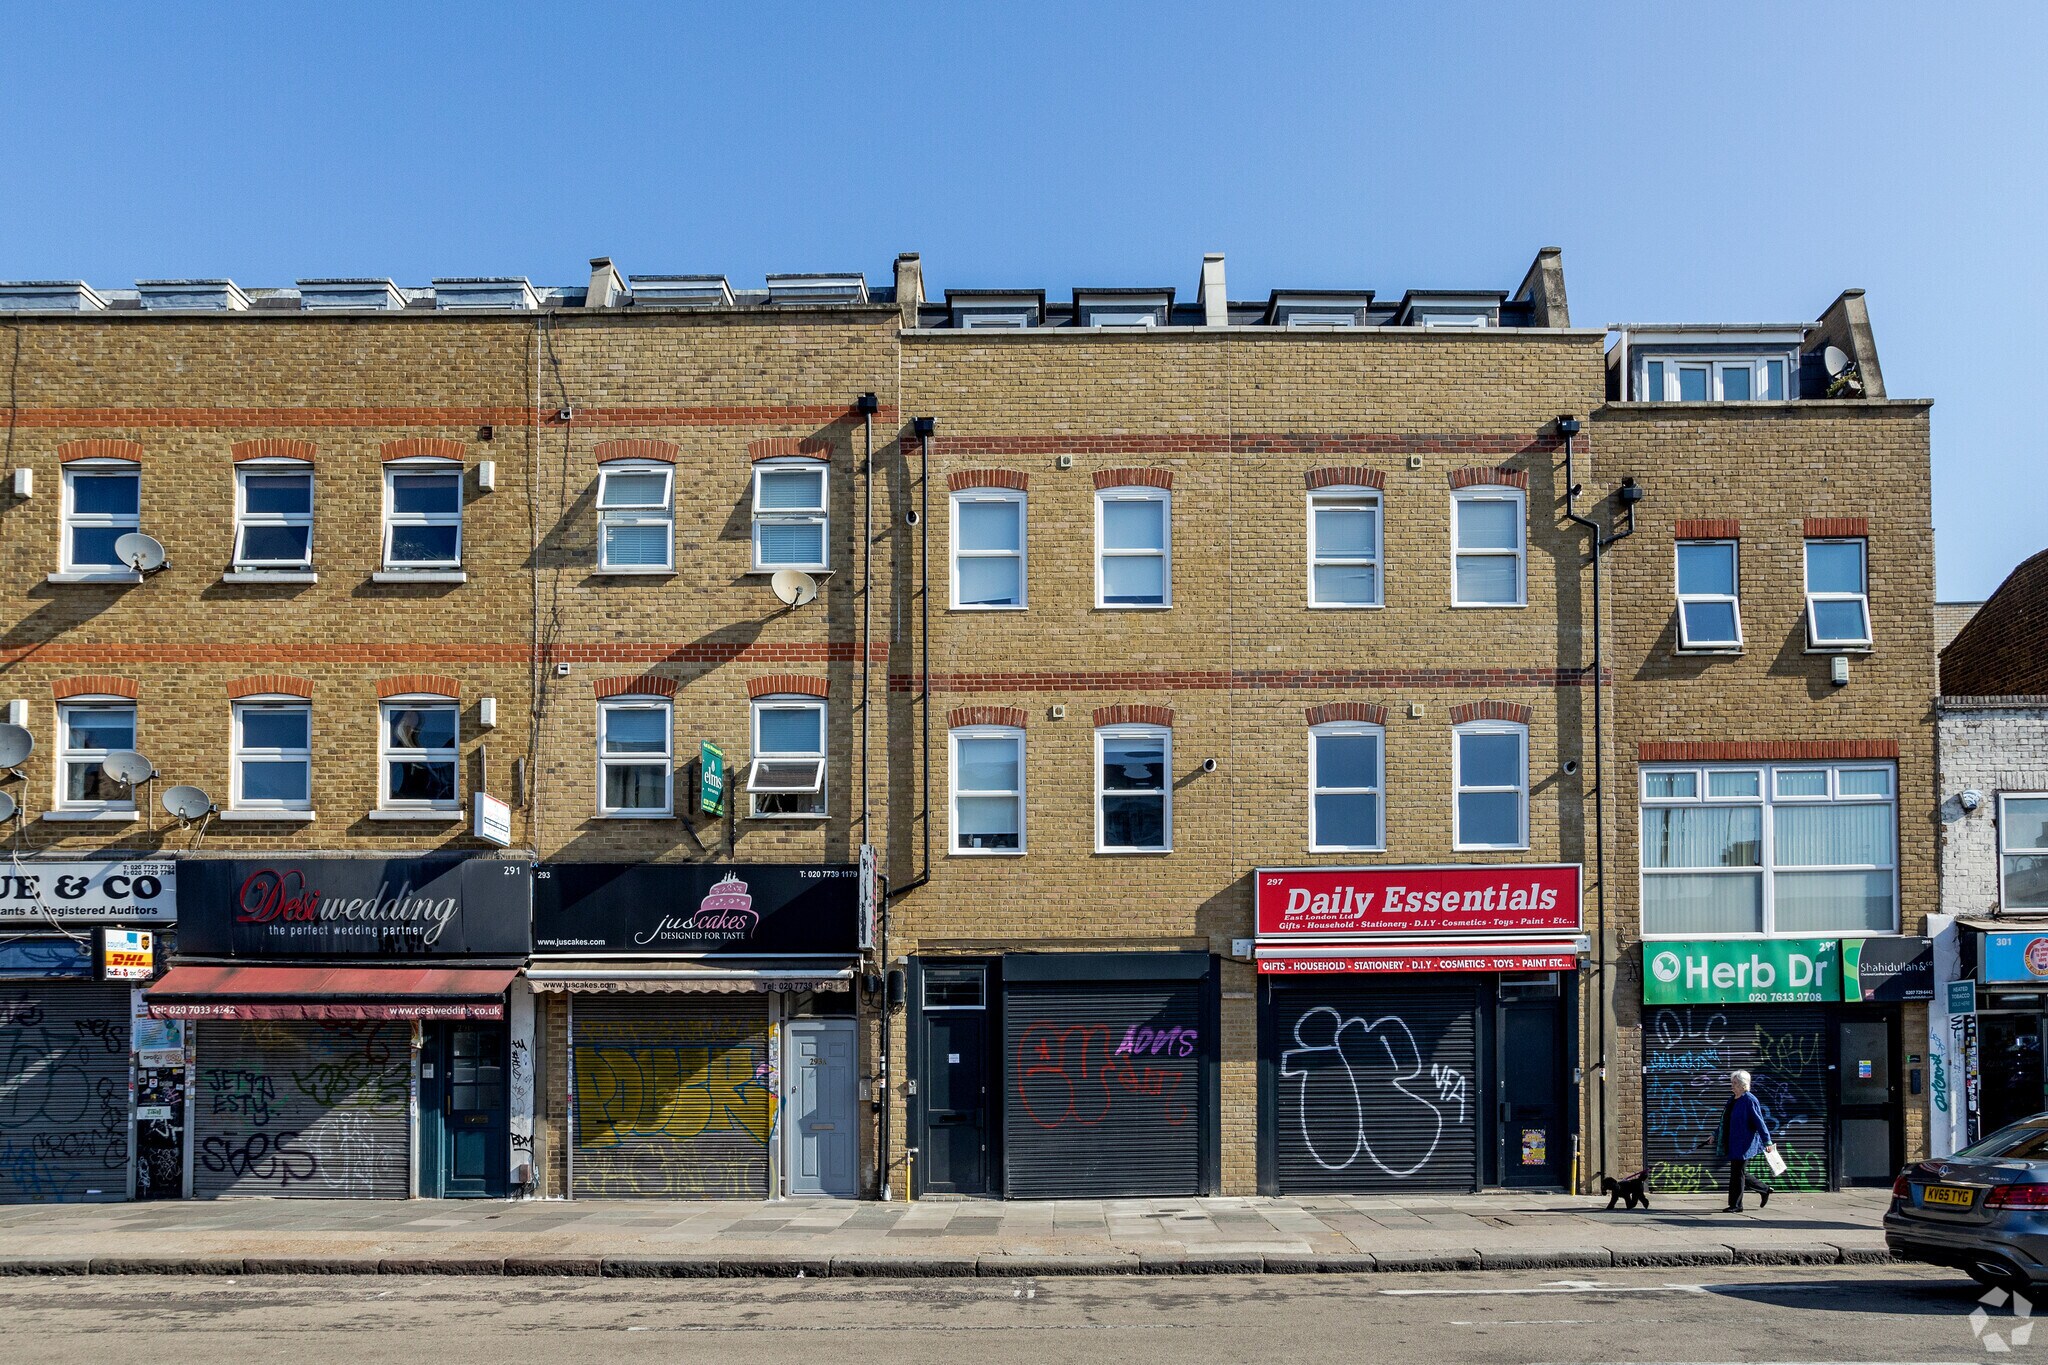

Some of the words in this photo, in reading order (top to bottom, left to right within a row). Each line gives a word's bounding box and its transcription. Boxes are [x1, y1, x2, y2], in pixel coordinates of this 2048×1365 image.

[704, 767, 721, 789] elms
[504, 866, 520, 875] 291
[1266, 878, 1283, 886] 297
[54, 875, 91, 900] &
[103, 875, 162, 900] CO
[1284, 886, 1375, 919] Daily
[1381, 883, 1558, 913] Essentials
[30, 906, 39, 915] &
[109, 905, 158, 915] Auditors
[1279, 922, 1301, 931] Gifts
[1307, 921, 1355, 929] Household
[1361, 920, 1408, 929] Stationery
[1414, 919, 1437, 927] D.I.Y
[1442, 918, 1487, 927] Cosmetics
[1493, 918, 1514, 927] Toys
[1520, 917, 1544, 925] Paint
[269, 925, 286, 935] the
[290, 925, 328, 937] perfect
[333, 925, 378, 937] wedding
[383, 925, 424, 937] partner
[661, 932, 702, 940] DESIGNED
[704, 932, 720, 940] FOR
[722, 932, 745, 940] TASTE
[537, 938, 606, 947] www.juscakes.com
[1996, 938, 2012, 946] 301
[1819, 942, 1837, 953] 299
[112, 953, 146, 966] DHL
[1262, 962, 1286, 971] GIFTS
[1293, 961, 1346, 971] HOUSEHOLD
[1354, 961, 1405, 970] STATIONERY
[1412, 960, 1432, 969] D.I.Y
[1440, 959, 1486, 969] COSMETICS
[1493, 959, 1514, 968] TOYS
[1522, 959, 1547, 968] PAINT
[1860, 962, 1918, 972] Shahidullah
[1686, 954, 1776, 989] Herb
[1788, 953, 1828, 987] Dr
[543, 981, 617, 990] www.juscakes.com
[762, 982, 777, 990] Tel:
[779, 982, 793, 990] 020
[795, 982, 813, 990] 7739
[1749, 993, 1768, 1002] 020
[1770, 993, 1794, 1002] 7613
[1796, 992, 1822, 1002] 9708
[150, 1006, 166, 1014] Tel:
[169, 1006, 187, 1014] 020
[189, 1006, 210, 1014] 7033
[389, 1005, 500, 1016] www.desiwedding.co.uk
[1928, 1187, 1950, 1199] KV65
[1951, 1190, 1969, 1203] TYG
